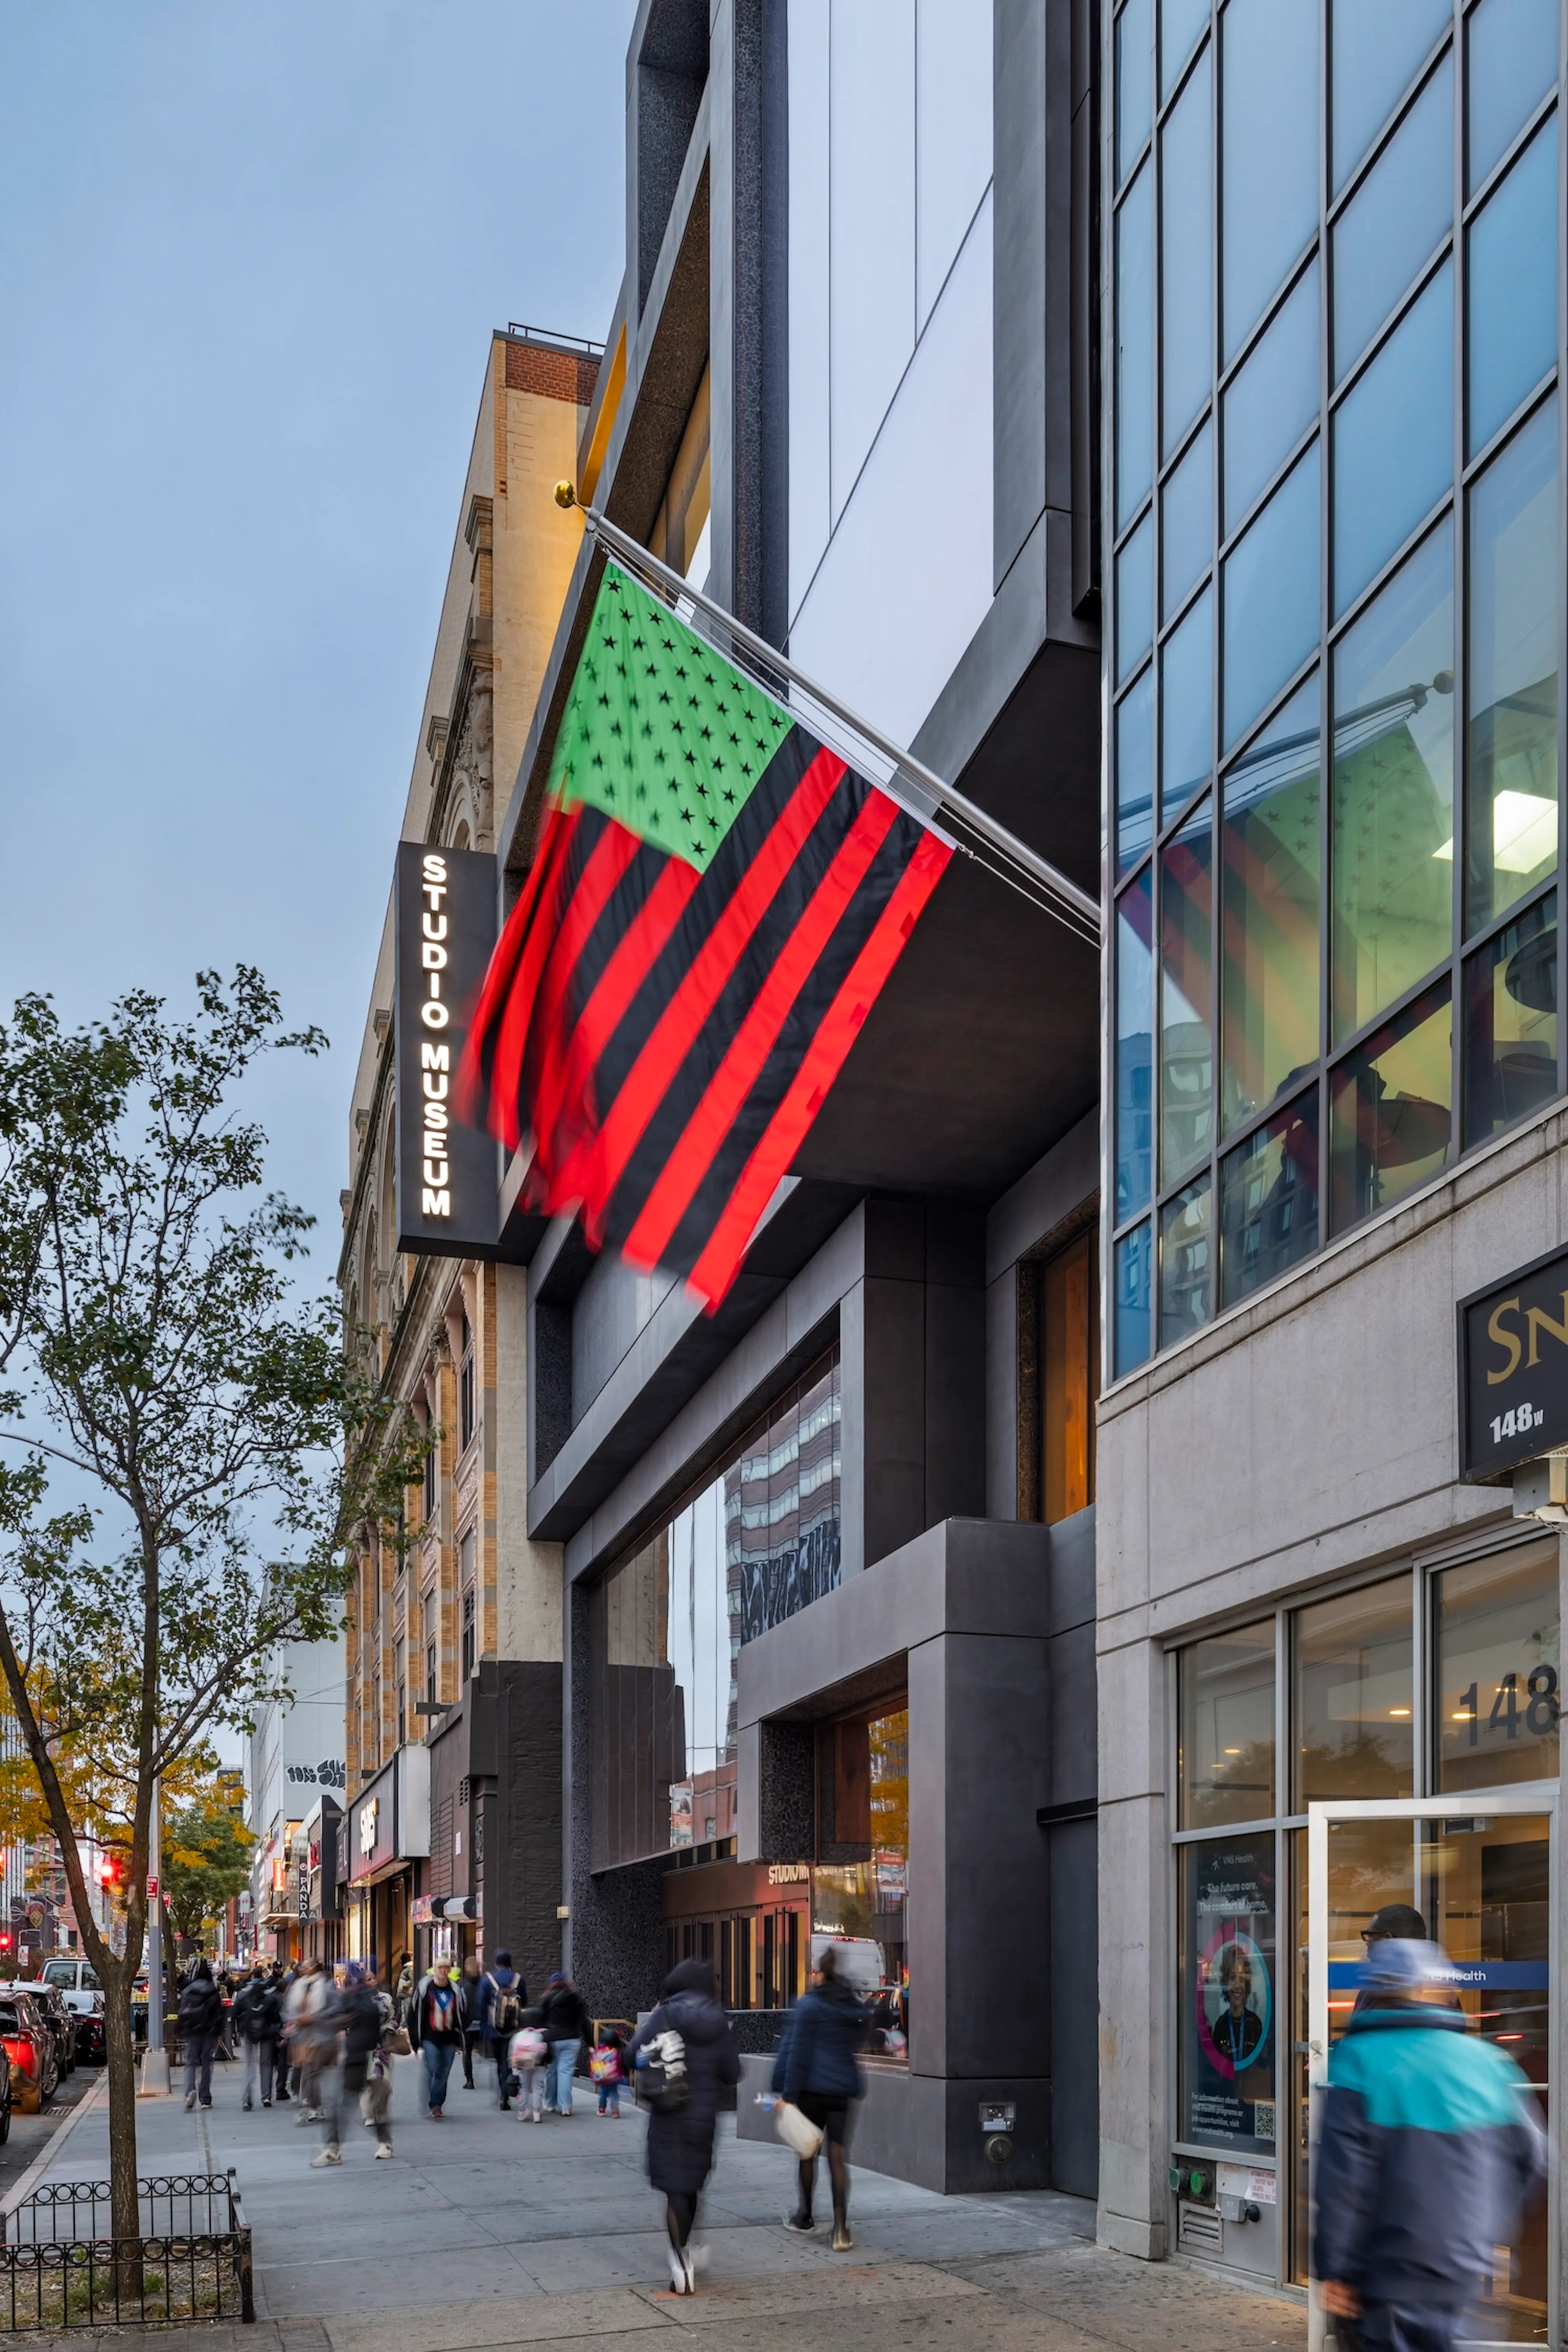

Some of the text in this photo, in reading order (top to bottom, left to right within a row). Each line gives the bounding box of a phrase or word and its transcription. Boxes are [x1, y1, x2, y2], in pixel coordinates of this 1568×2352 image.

[421, 854, 450, 1217] STUDIO MUSEUM
[1460, 1664, 1559, 1747] 148
[1223, 1852, 1254, 1865] VNS Health
[768, 1865, 798, 1885] STUDIO
[1207, 1883, 1219, 1893] The
[1220, 1882, 1240, 1892] future
[300, 1877, 308, 1919] PANDA
[1199, 1902, 1211, 1911] The
[1211, 1901, 1237, 1911] comfort
[1238, 1899, 1245, 1910] of
[1446, 1970, 1486, 1981] Health
